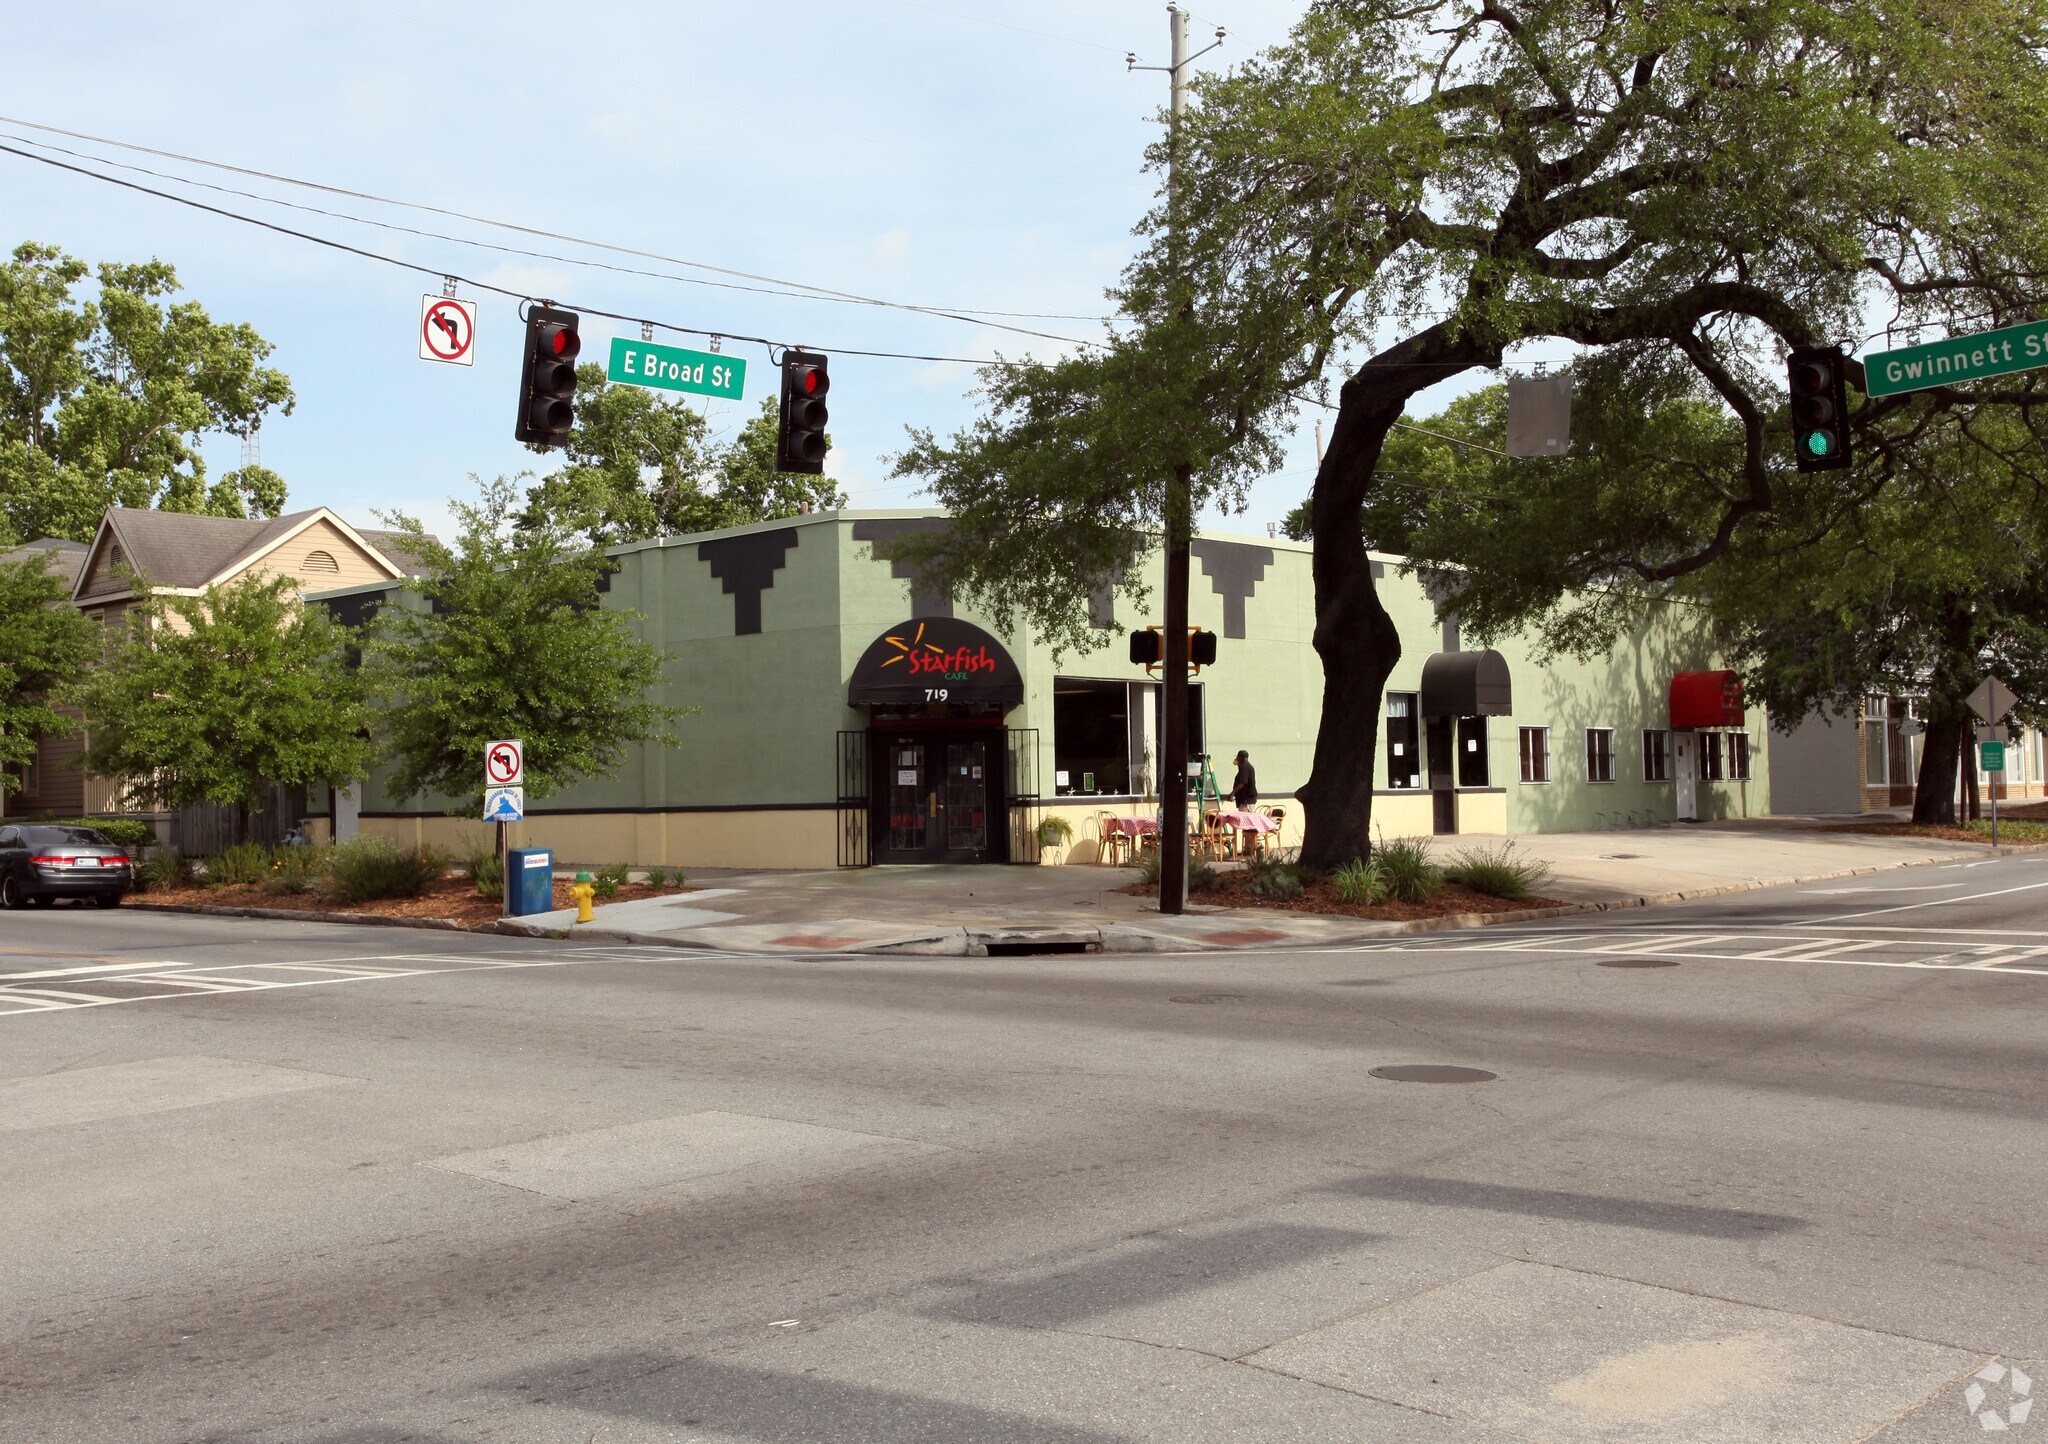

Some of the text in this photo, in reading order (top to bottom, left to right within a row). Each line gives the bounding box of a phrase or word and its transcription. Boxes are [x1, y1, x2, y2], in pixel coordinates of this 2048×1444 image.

[623, 350, 732, 389] E Broad St
[1886, 340, 2013, 382] Gwinnett
[909, 645, 995, 674] Starfish
[944, 672, 968, 680] CAFE
[924, 688, 949, 702] 719
